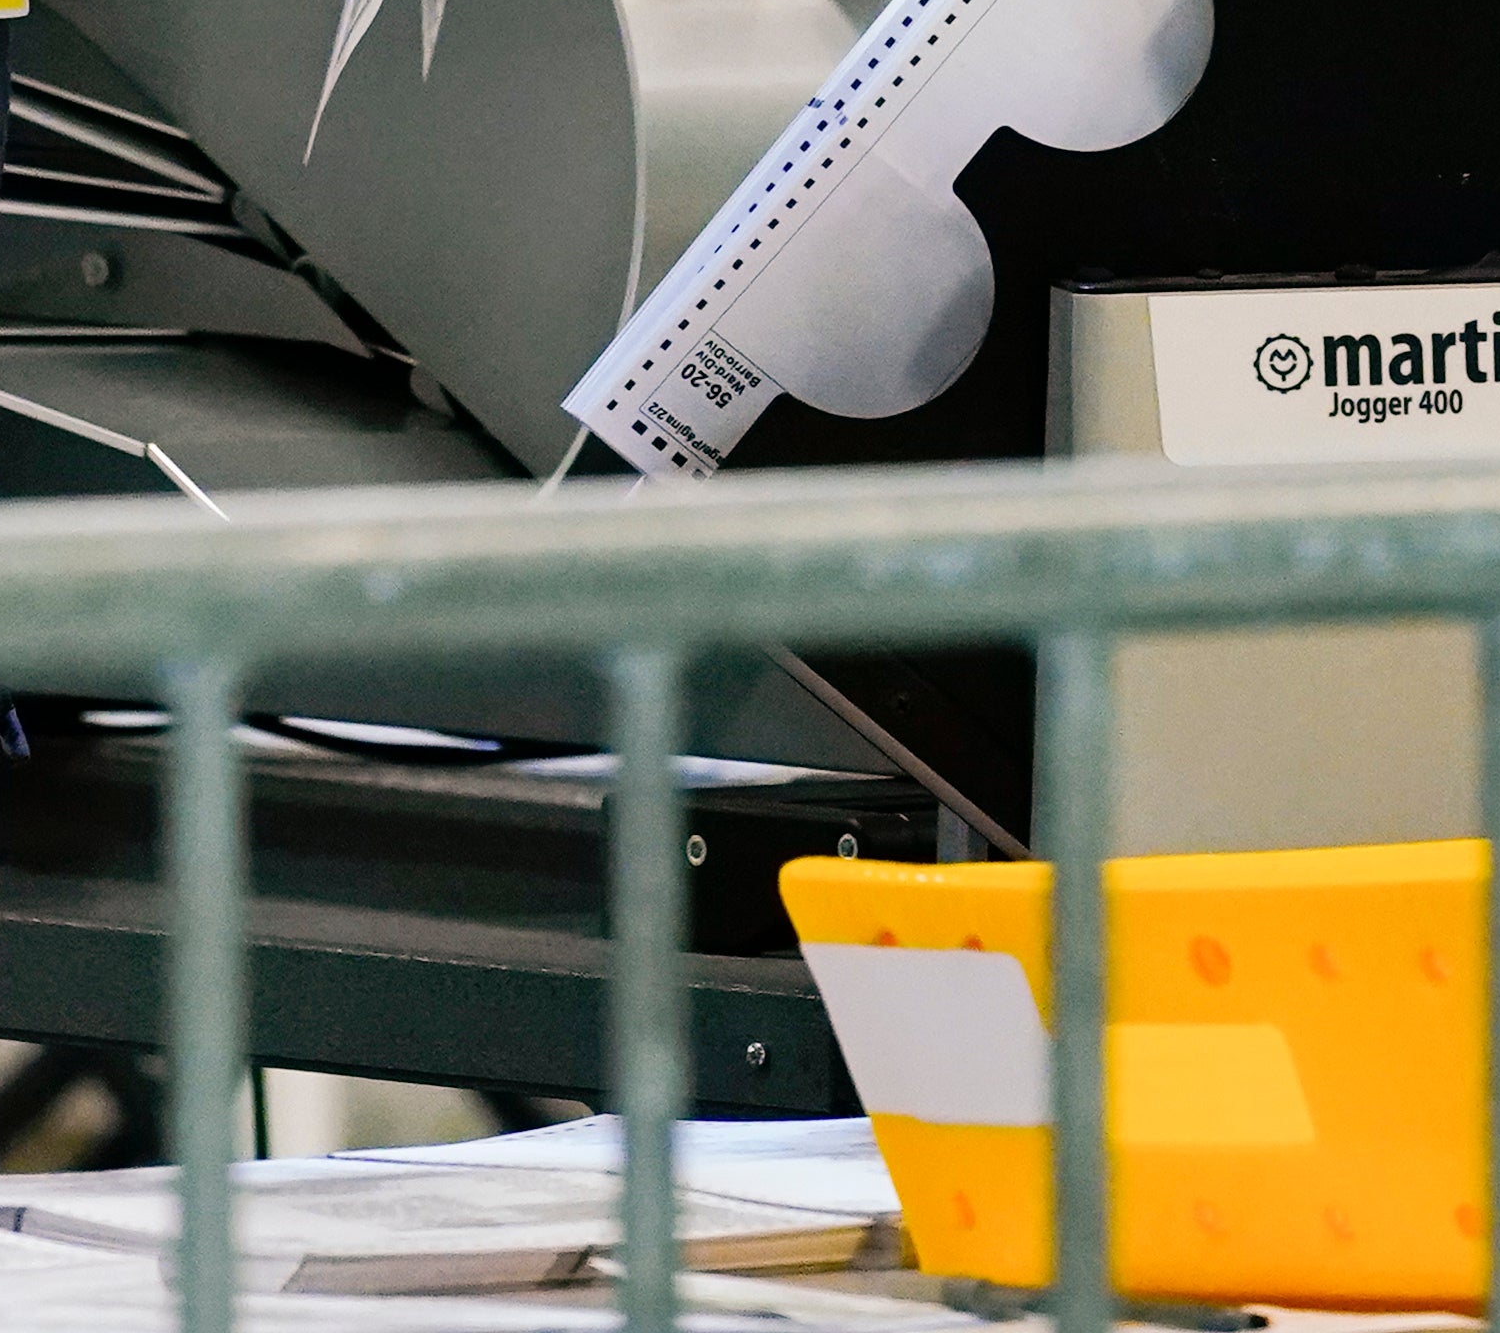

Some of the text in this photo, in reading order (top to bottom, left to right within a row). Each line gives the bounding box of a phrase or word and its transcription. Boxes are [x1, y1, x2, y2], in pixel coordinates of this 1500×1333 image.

[680, 363, 733, 409] 56-20
[695, 350, 746, 394] Ward-Div
[704, 340, 761, 388] Barrio-Div
[1328, 390, 1464, 422] Jogger 400
[647, 402, 726, 465] age/Página 2/2
